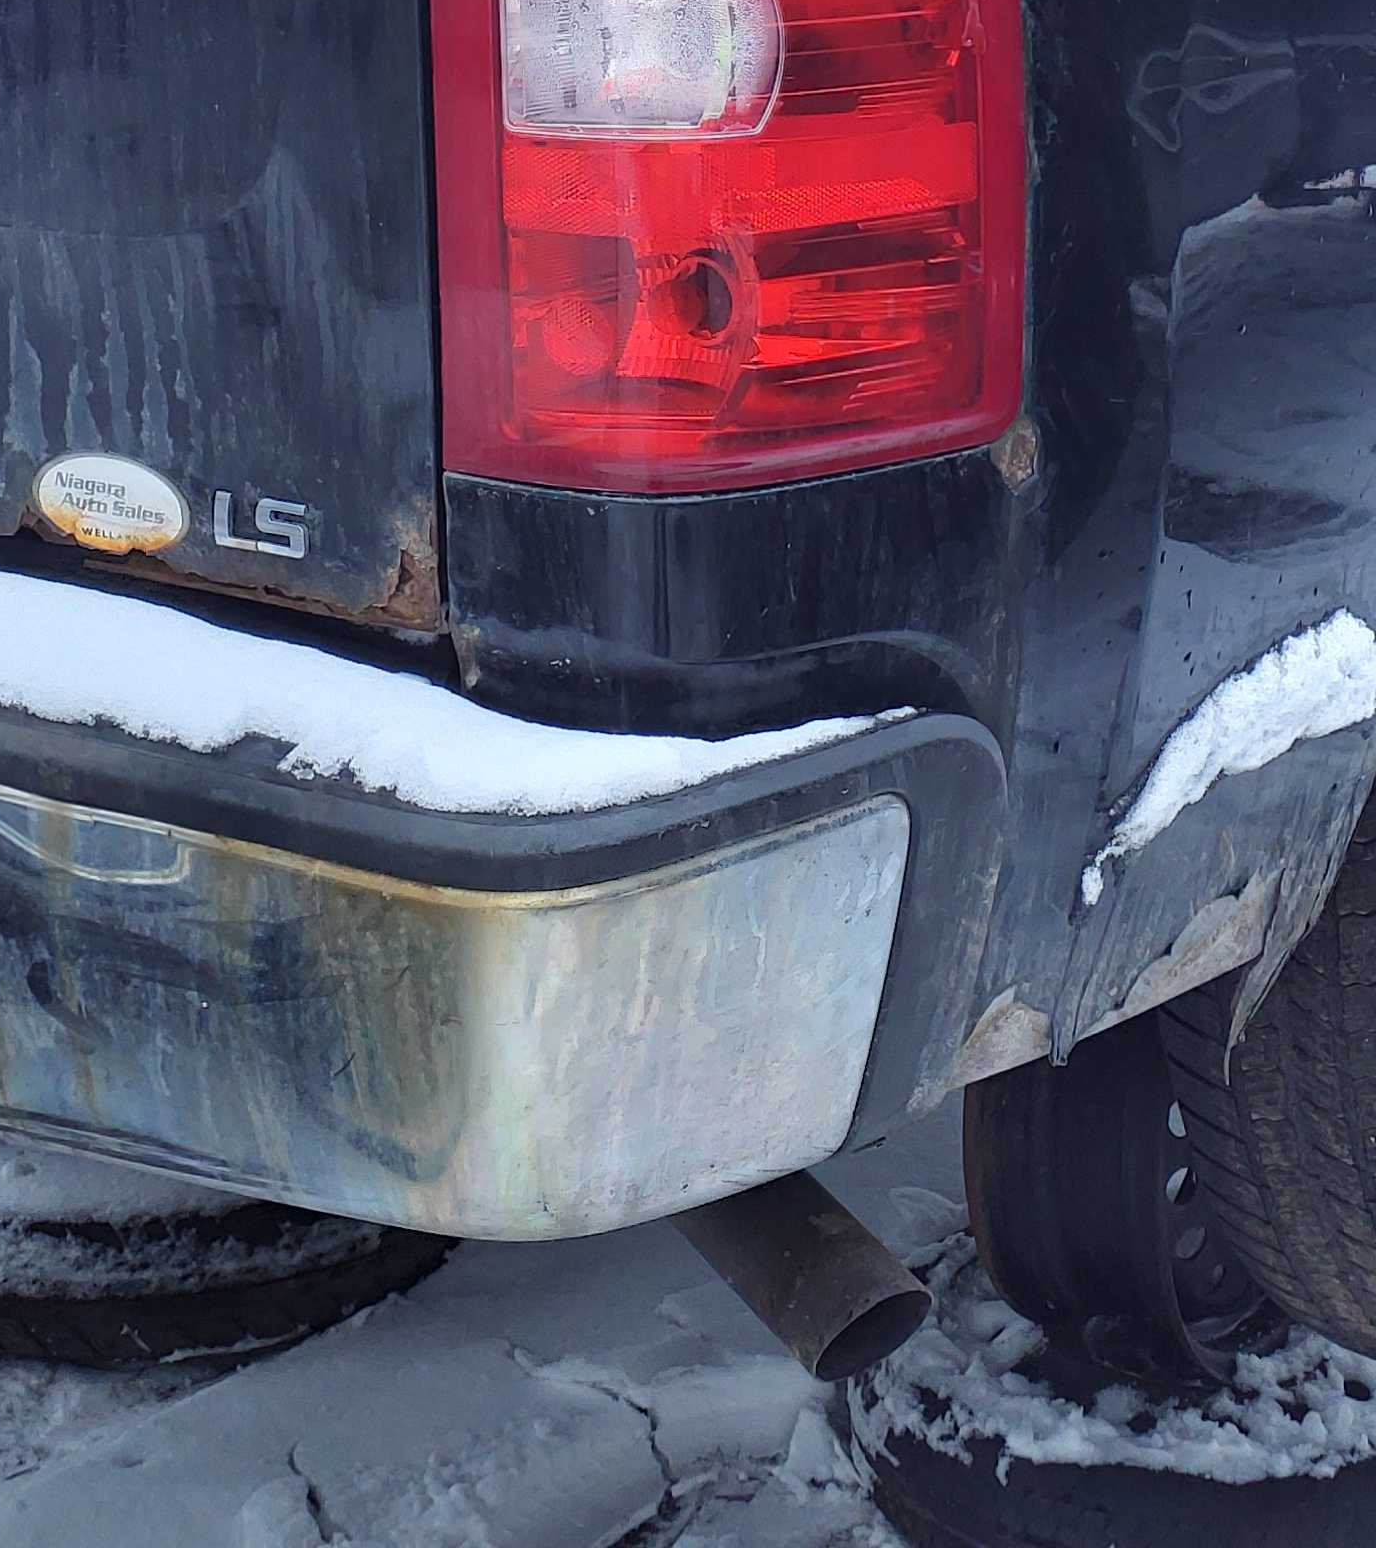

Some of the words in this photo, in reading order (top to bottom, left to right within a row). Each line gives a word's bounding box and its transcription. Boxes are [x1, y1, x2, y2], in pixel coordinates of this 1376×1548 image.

[55, 471, 126, 498] Niagara
[61, 492, 108, 513] Auto
[111, 500, 165, 524] Sales
[213, 490, 309, 559] LS
